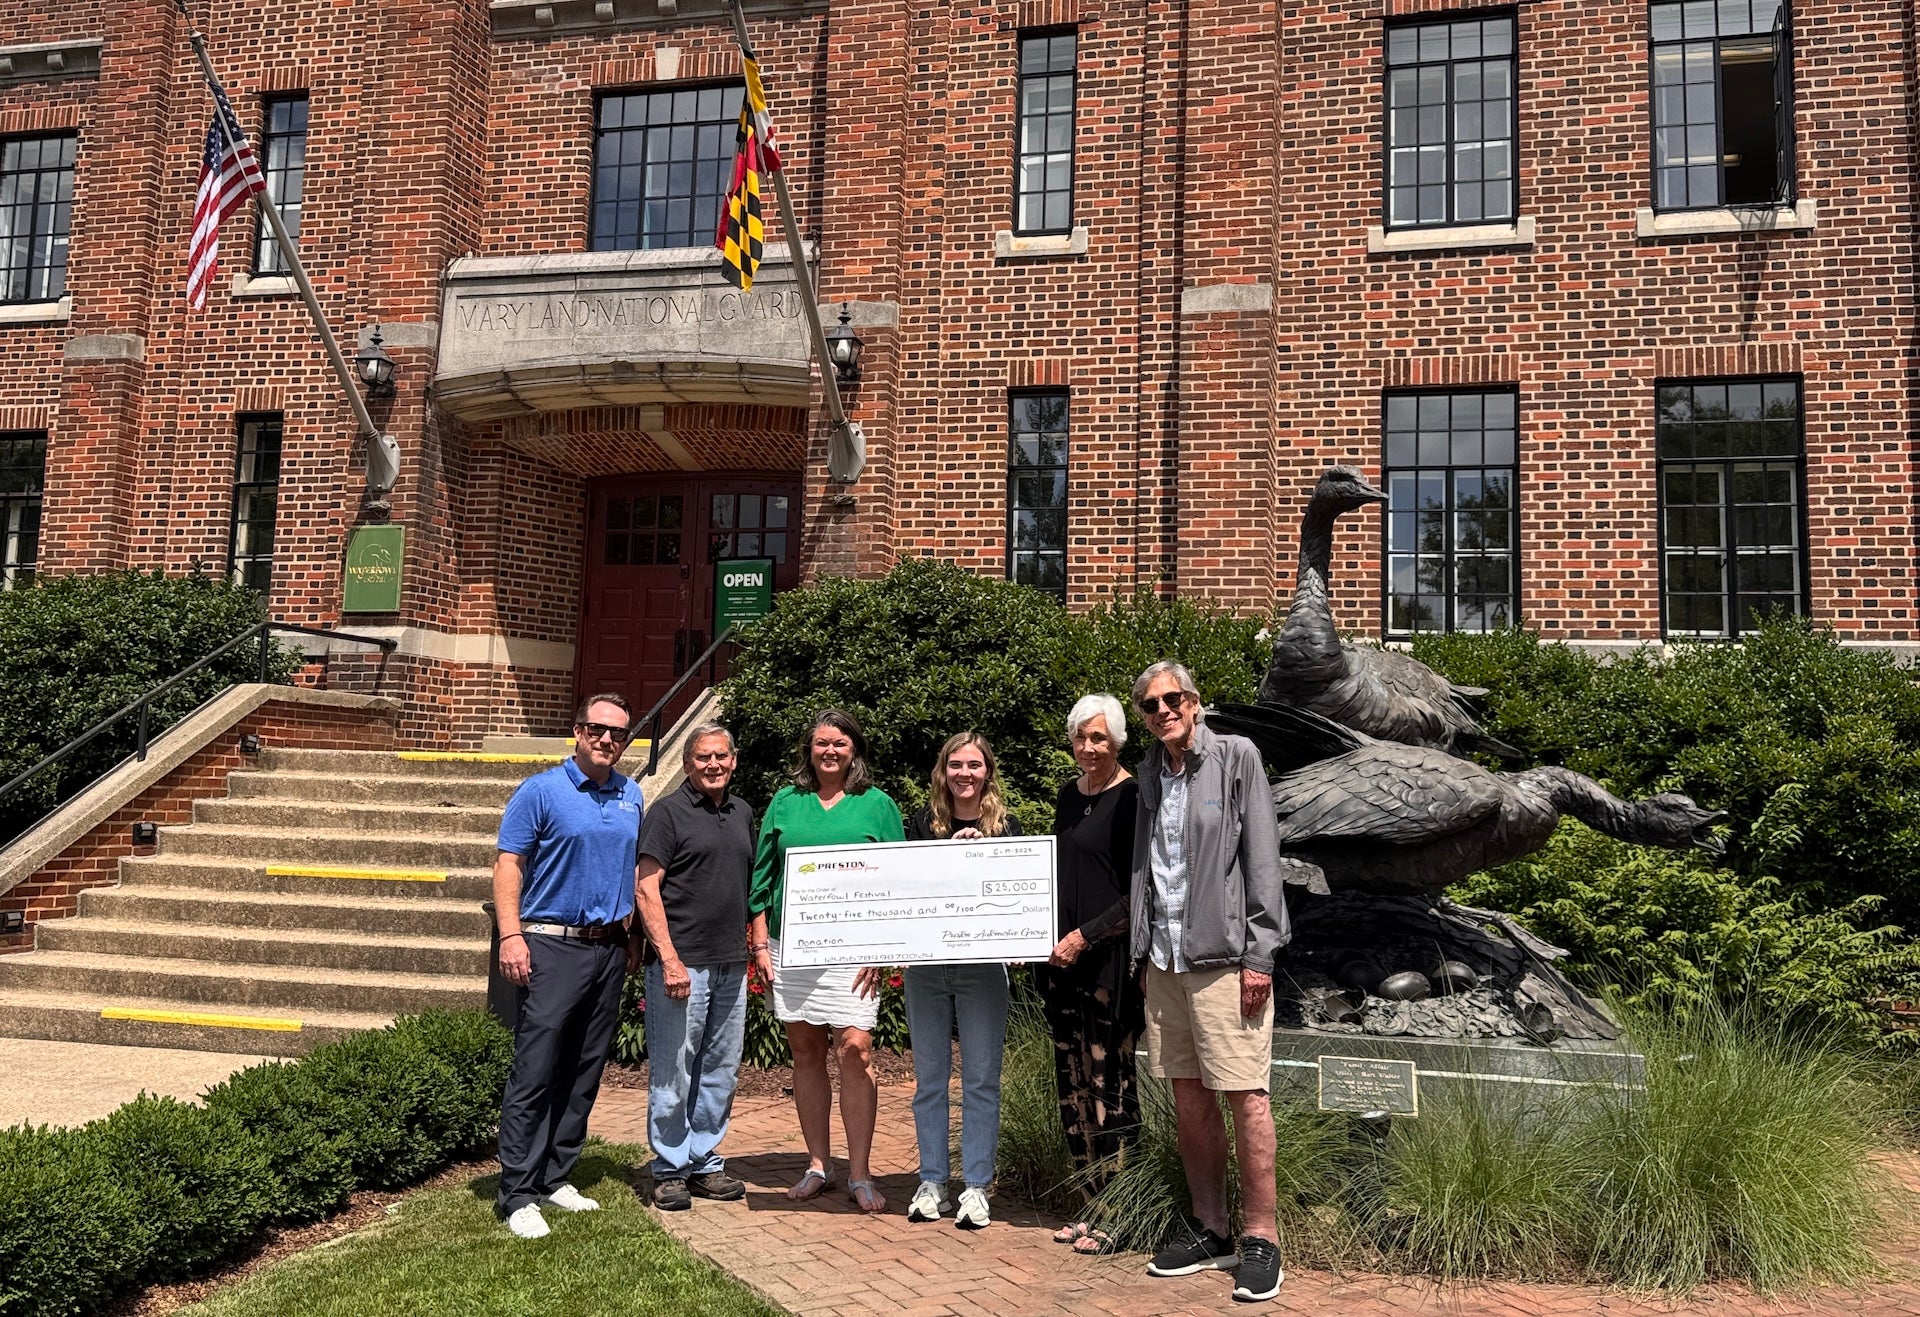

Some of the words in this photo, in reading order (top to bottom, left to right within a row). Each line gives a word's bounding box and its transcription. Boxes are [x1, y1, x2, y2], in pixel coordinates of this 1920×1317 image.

[594, 295, 715, 328] NATIONAL
[723, 572, 764, 588] OPEN
[965, 851, 984, 859] Date
[818, 861, 866, 870] PRESTON
[799, 892, 849, 902] Waterfowl
[854, 890, 891, 899] Festival
[799, 910, 862, 921] Twenty-five
[868, 907, 913, 917] thousand
[918, 905, 937, 914] and
[1022, 905, 1051, 913] Dollars
[798, 938, 844, 947] Donation
